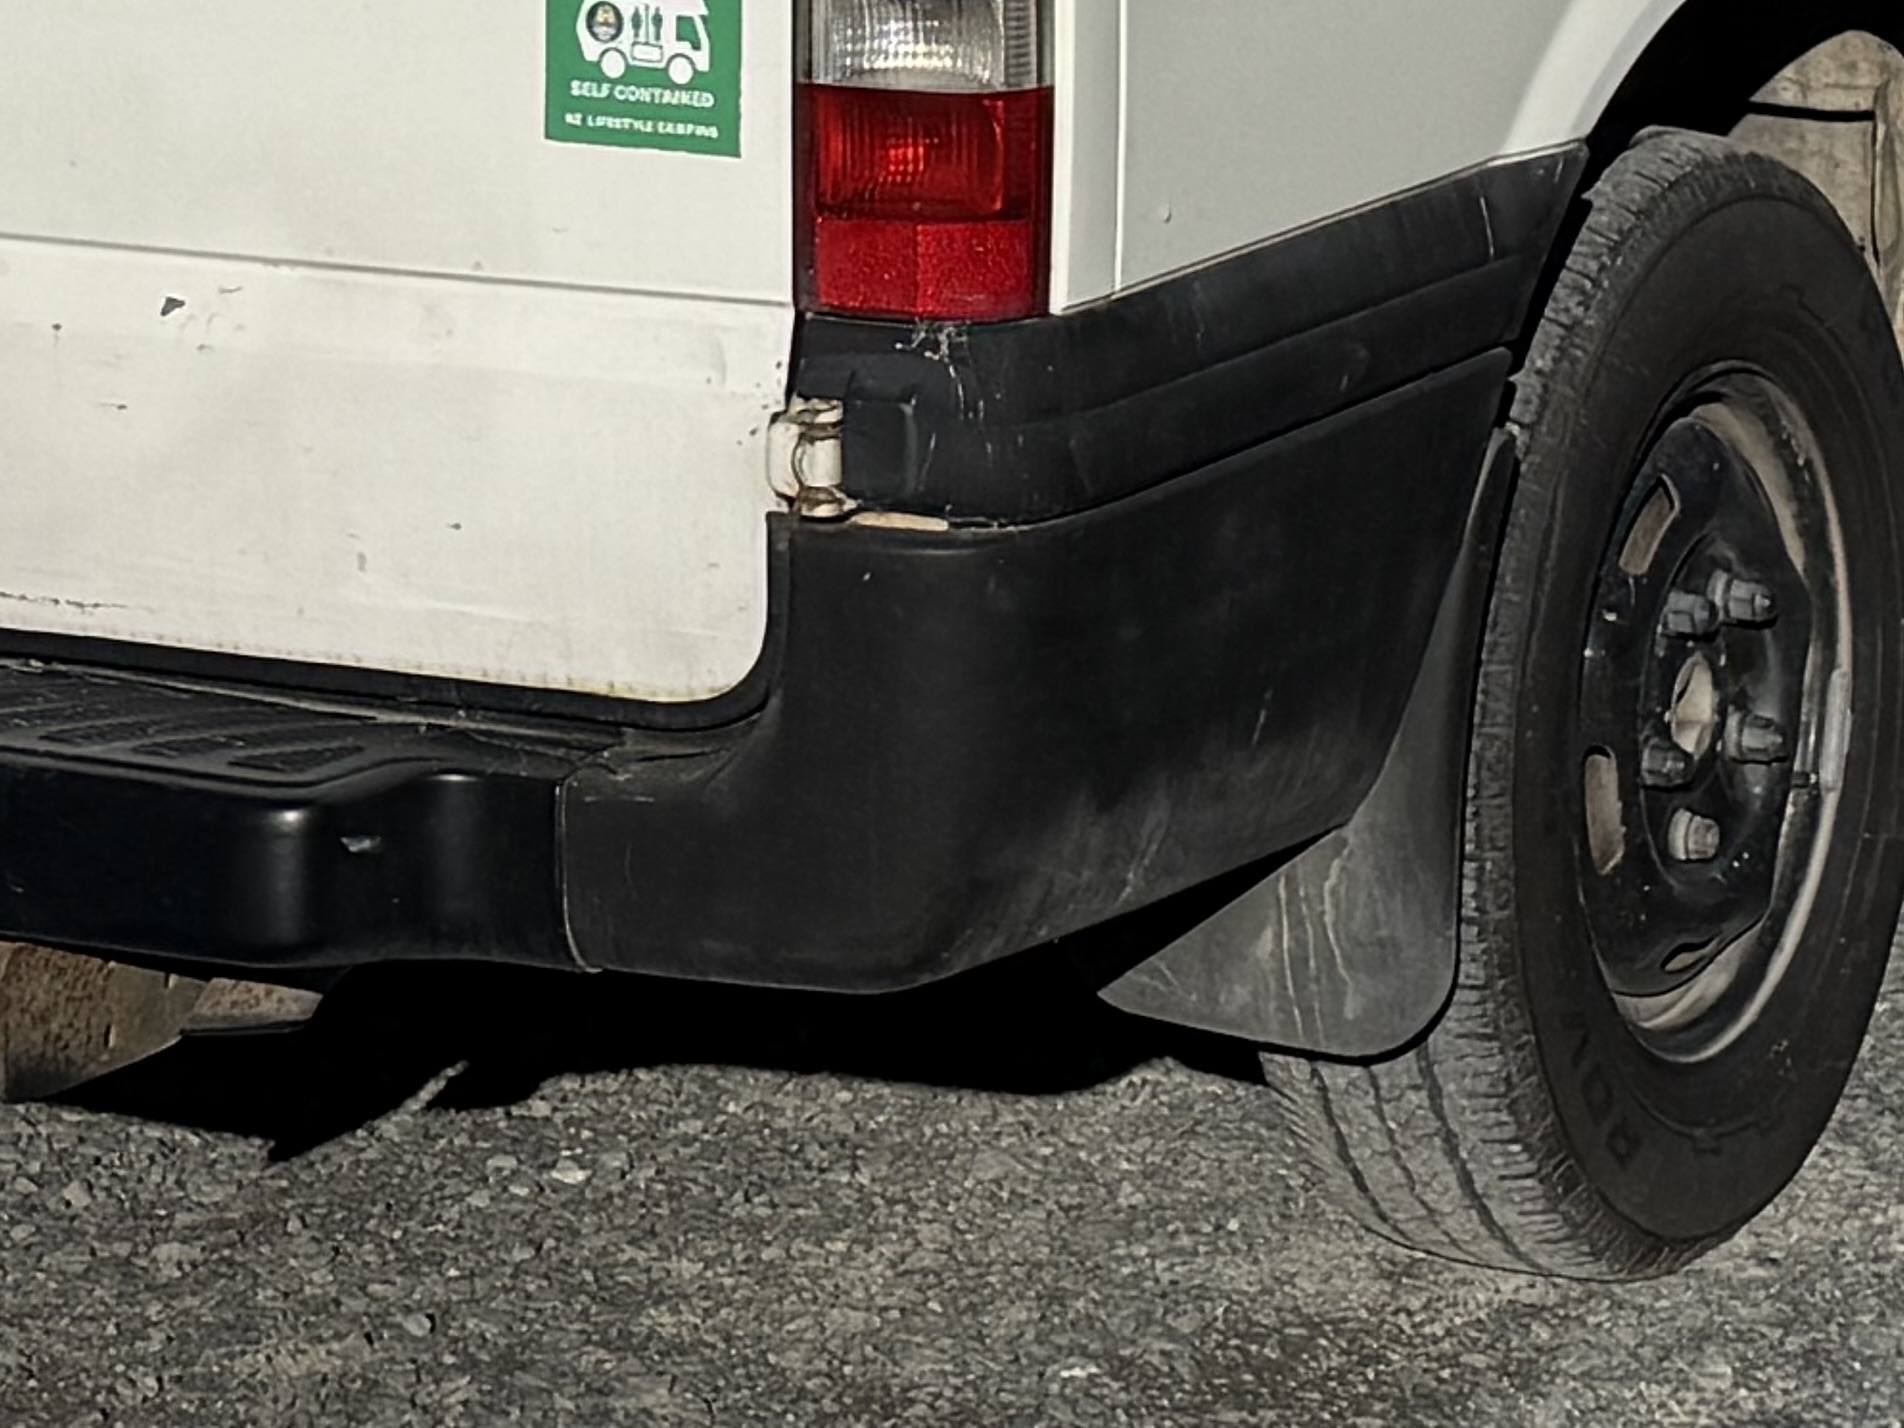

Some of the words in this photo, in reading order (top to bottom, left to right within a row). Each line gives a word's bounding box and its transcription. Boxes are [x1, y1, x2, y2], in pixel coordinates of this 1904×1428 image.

[570, 80, 611, 98] SELF
[613, 85, 715, 107] CONTAINED
[587, 115, 654, 133] LIFESTYLE
[657, 121, 719, 138] CAMPING
